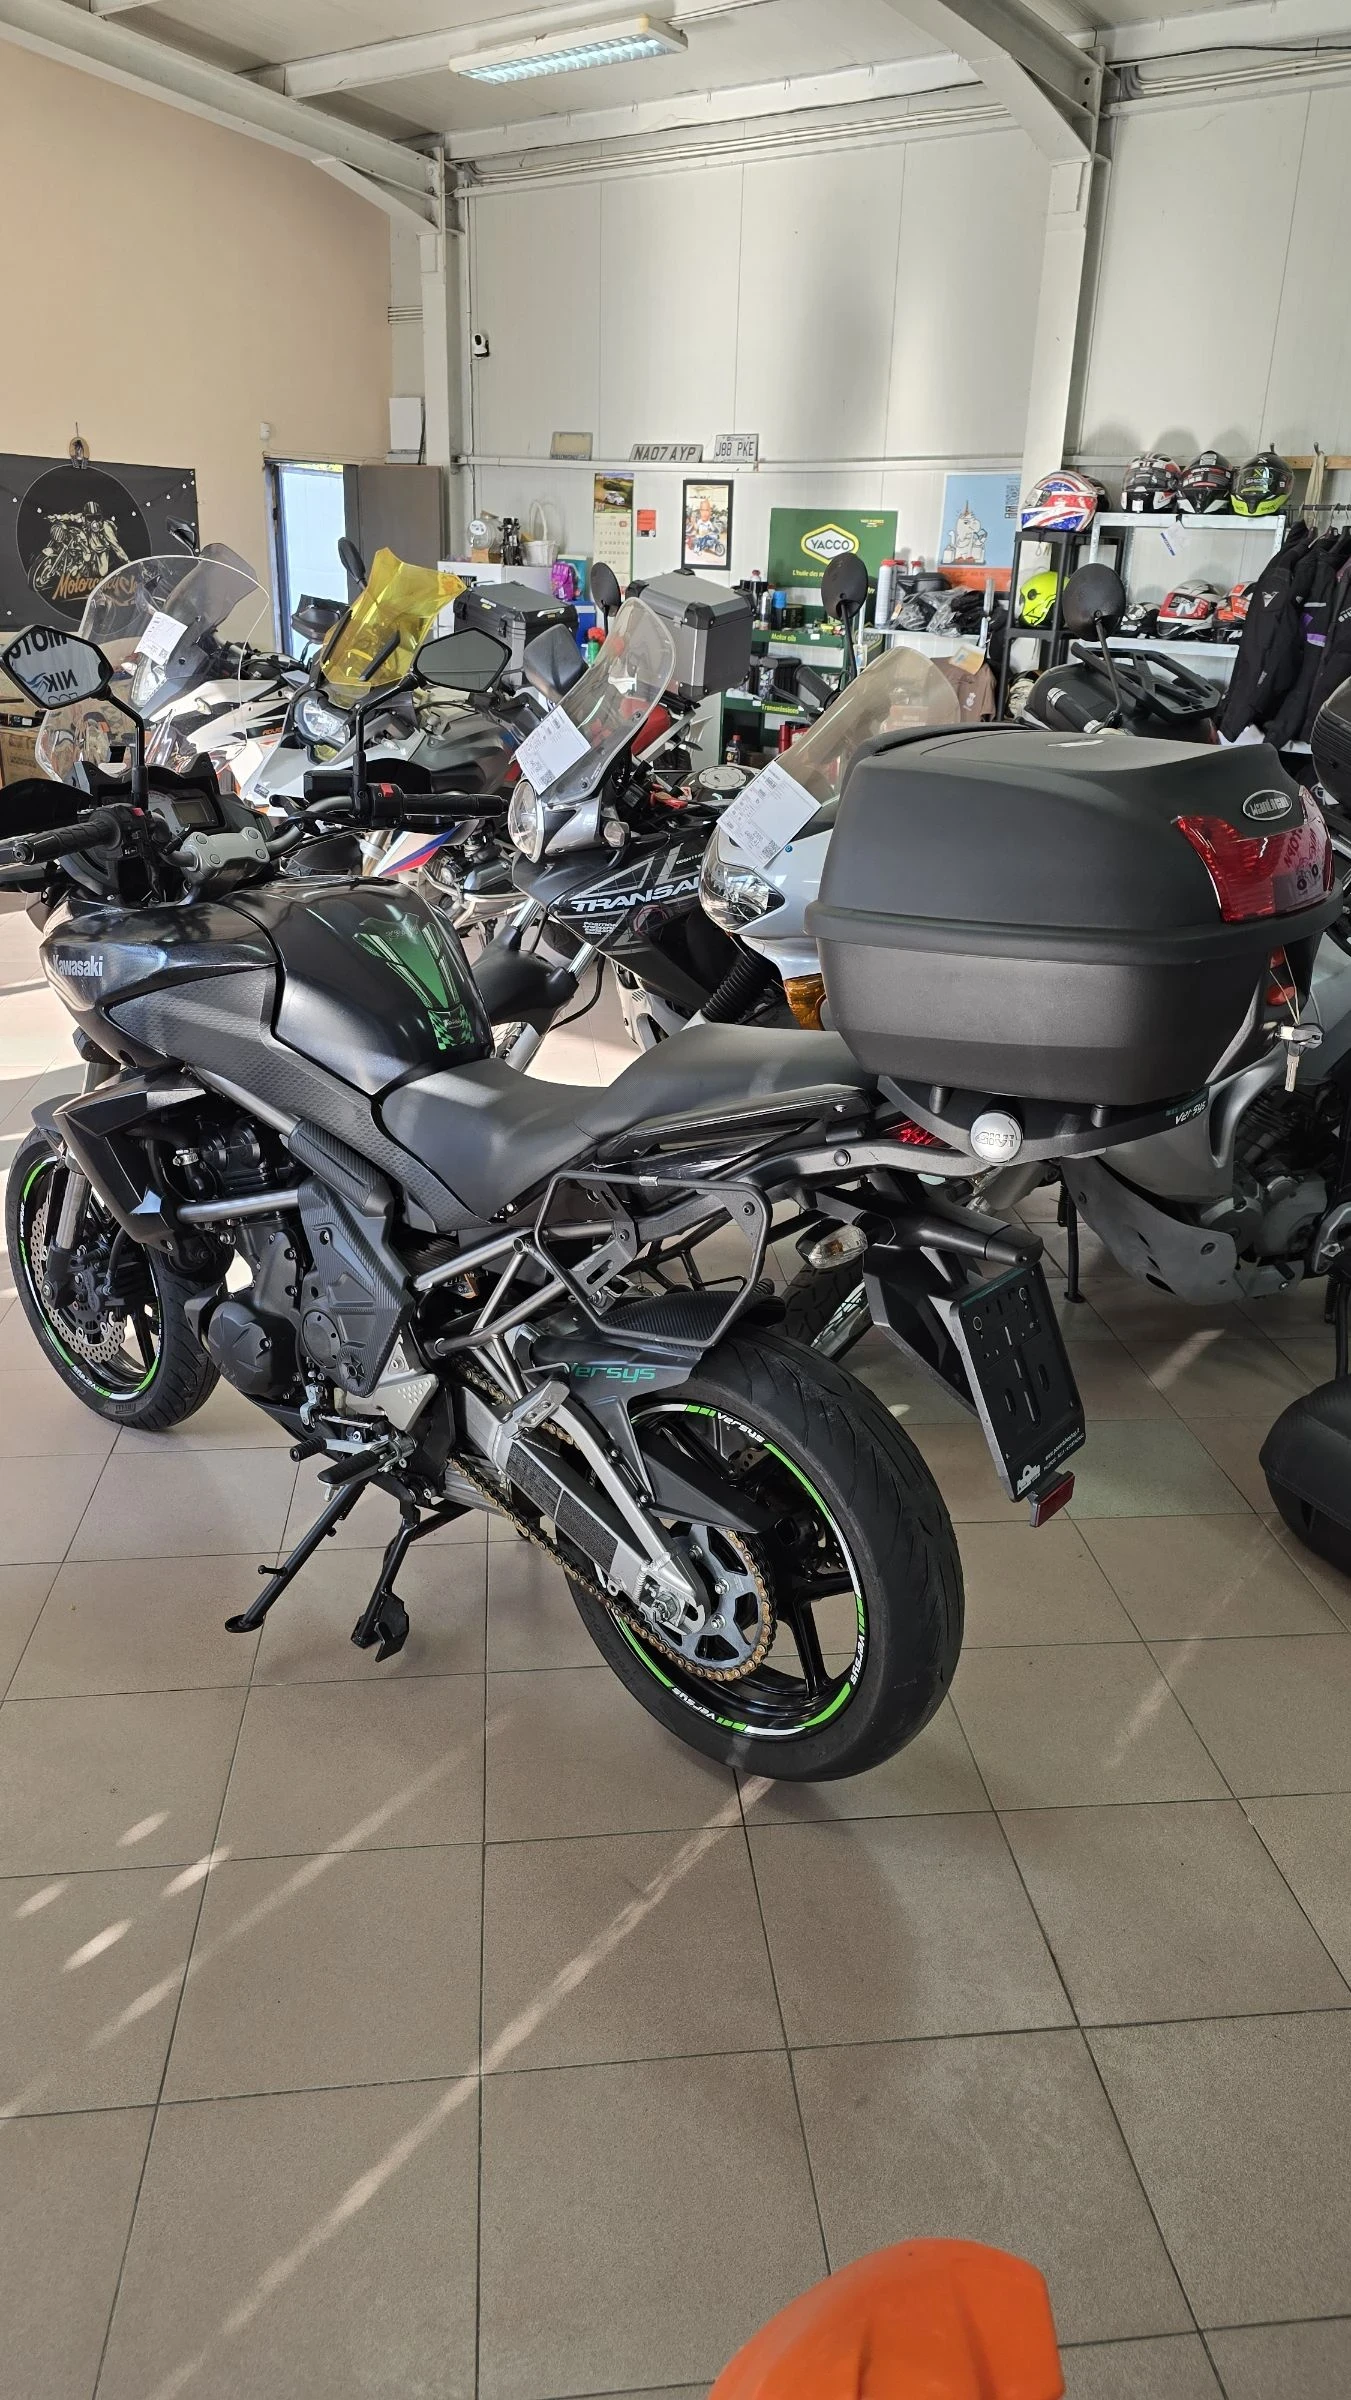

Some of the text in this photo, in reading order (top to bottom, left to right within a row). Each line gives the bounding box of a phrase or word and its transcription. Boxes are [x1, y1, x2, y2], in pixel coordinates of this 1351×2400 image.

[634, 446, 696, 460] NA07 AYP
[737, 441, 754, 456] PKE
[811, 539, 850, 550] YACCO
[52, 954, 104, 977] Kawasaki
[975, 1131, 1015, 1147] GIVI
